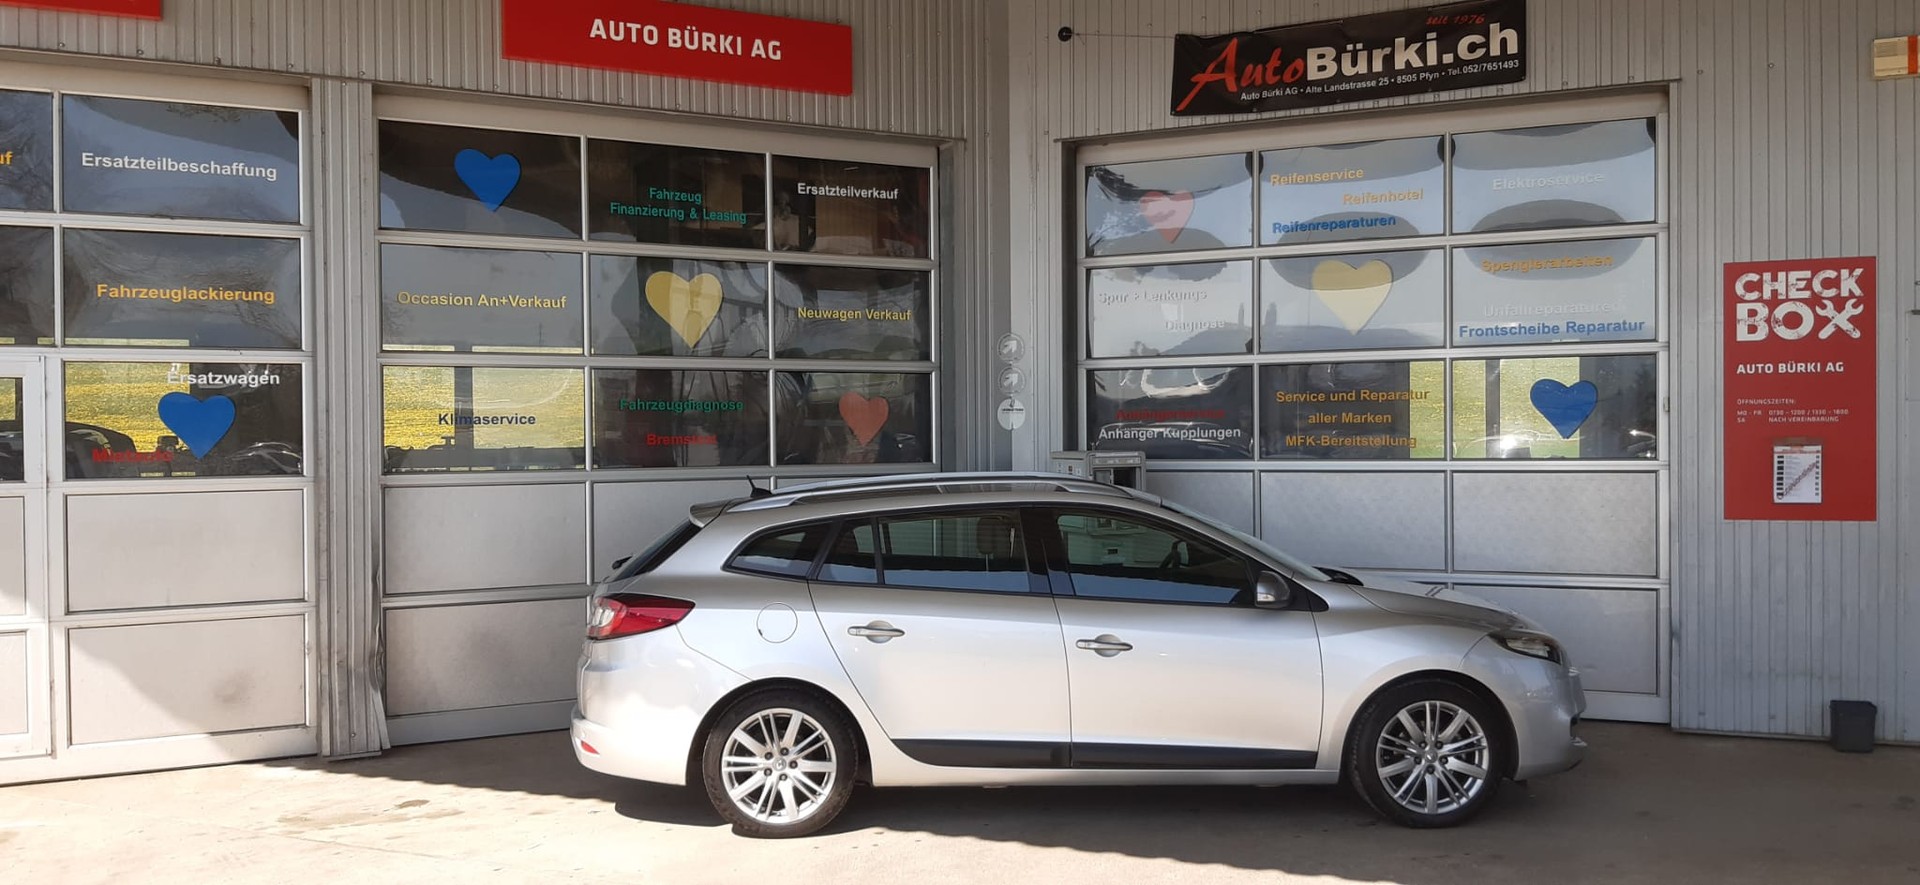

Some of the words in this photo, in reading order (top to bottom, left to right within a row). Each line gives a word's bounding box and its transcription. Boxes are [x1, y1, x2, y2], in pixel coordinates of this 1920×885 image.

[1454, 13, 1487, 24] 1976
[589, 18, 659, 46] AUTO
[667, 25, 742, 56] BÜRKI
[750, 38, 782, 61] AG
[1240, 91, 1260, 101] Auto
[1262, 87, 1283, 98] Bürki
[1285, 86, 1298, 96] AG
[1305, 85, 1322, 94] Alte
[1324, 78, 1376, 93] Landstrasse
[1378, 76, 1390, 87] 25
[1396, 73, 1418, 84] 8505
[1420, 72, 1439, 82] Pfyn
[81, 152, 278, 181] Ersatzteilbeschaffung
[1270, 168, 1364, 186] Reifenservice
[1491, 171, 1605, 191] Elektroservice
[649, 187, 702, 204] Fahrzeug
[797, 182, 899, 200] Ersatzteilverkauf
[1343, 188, 1424, 205] Reifenhotel
[610, 201, 685, 221] Finanzierung
[689, 207, 698, 220] &
[703, 210, 747, 225] Leasing
[1272, 215, 1397, 234] Reifenreparaturen
[1481, 255, 1614, 274] Spenglerarbeiten
[1734, 267, 1864, 301] CHECK
[96, 283, 276, 305] Fahrzeuglackierung
[396, 291, 474, 307] Occasion
[477, 293, 567, 309] An+Verkauf
[1098, 292, 1128, 306] Spur
[797, 306, 862, 322] Neuwagen
[865, 307, 912, 321] Verkauf
[1736, 299, 1864, 342] BOX
[1164, 318, 1226, 333] Diagnose
[1458, 322, 1561, 338] Frontscheibe
[1566, 319, 1646, 336] Reparatur
[1736, 363, 1774, 375] AUTO
[1777, 360, 1821, 374] BÜRKI
[1825, 361, 1845, 373] AG
[167, 371, 281, 388] Ersatzwagen
[1275, 390, 1325, 403] Service
[1329, 389, 1356, 402] und
[1360, 388, 1431, 404] Reparatur
[619, 398, 745, 414] Fahrzeugdiagnose
[438, 412, 537, 426] Klimaservice
[1307, 412, 1337, 424] aller
[1341, 411, 1392, 424] Marken
[1788, 415, 1840, 423] VEREINBARUNG
[1163, 426, 1241, 441] Kupplungen
[1285, 434, 1417, 449] MFK-Bereitstellung
